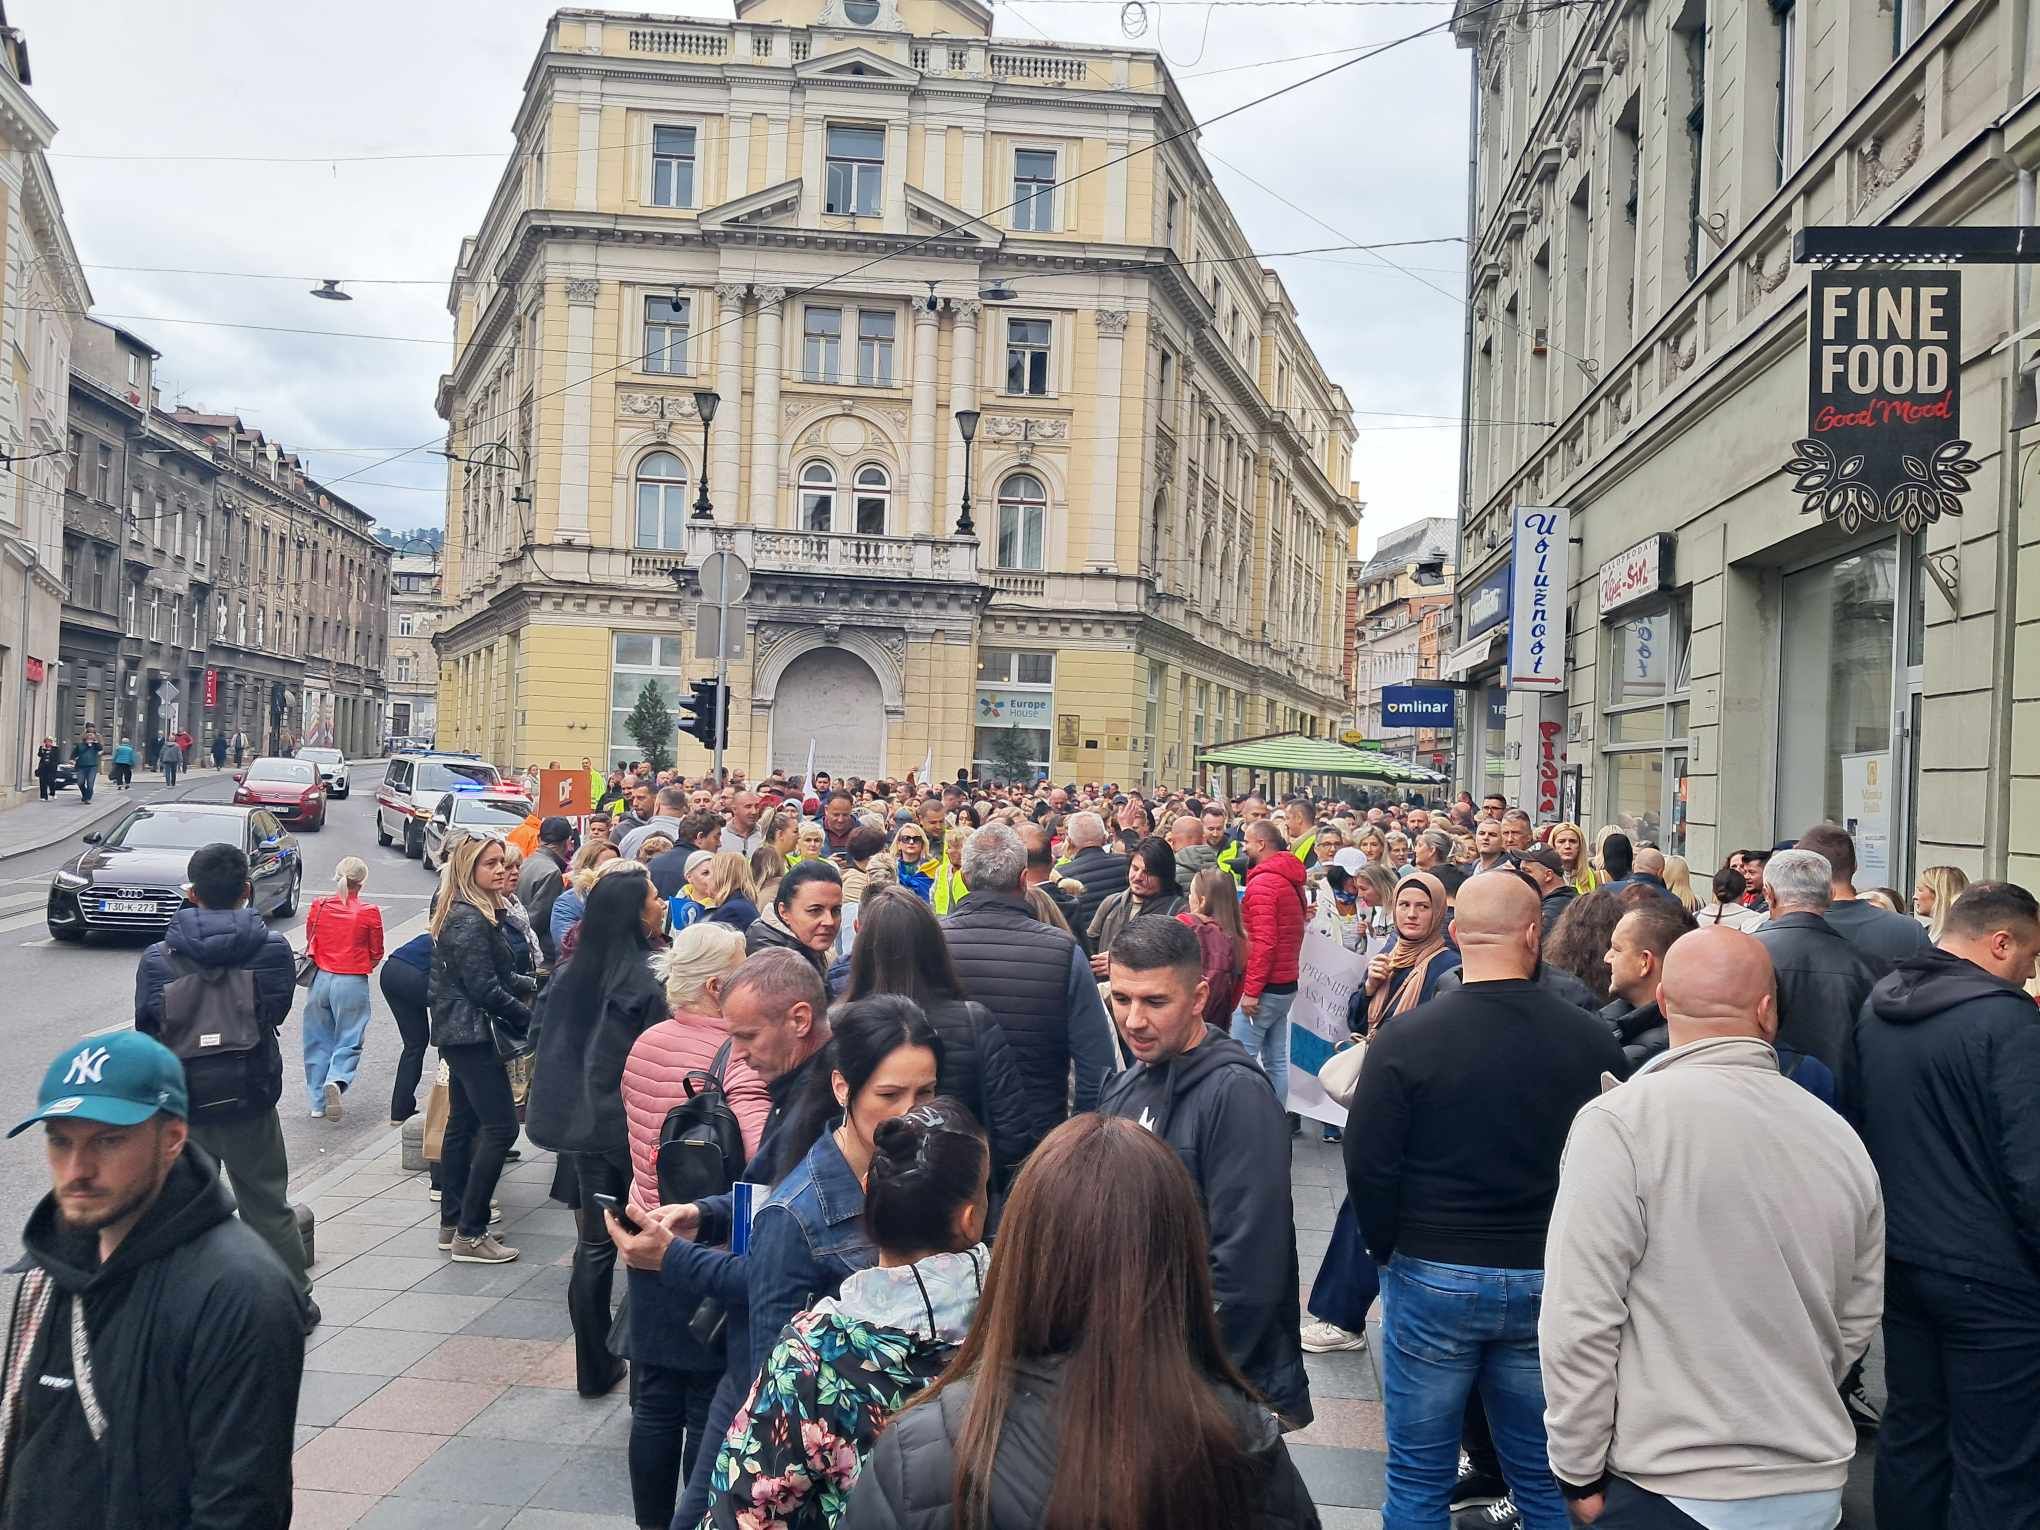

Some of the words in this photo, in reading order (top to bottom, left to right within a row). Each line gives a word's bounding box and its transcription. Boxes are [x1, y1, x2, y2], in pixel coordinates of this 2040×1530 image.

[1822, 287, 1949, 340] FINE
[1821, 345, 1948, 394] FOOD
[1814, 399, 1876, 432] Good
[1877, 391, 1953, 423] Mood
[1524, 513, 1558, 674] Uslužnost
[1009, 708, 1040, 718] House
[1010, 699, 1047, 710] Europe
[1399, 700, 1449, 713] mlinar
[63, 1046, 111, 1085] NY
